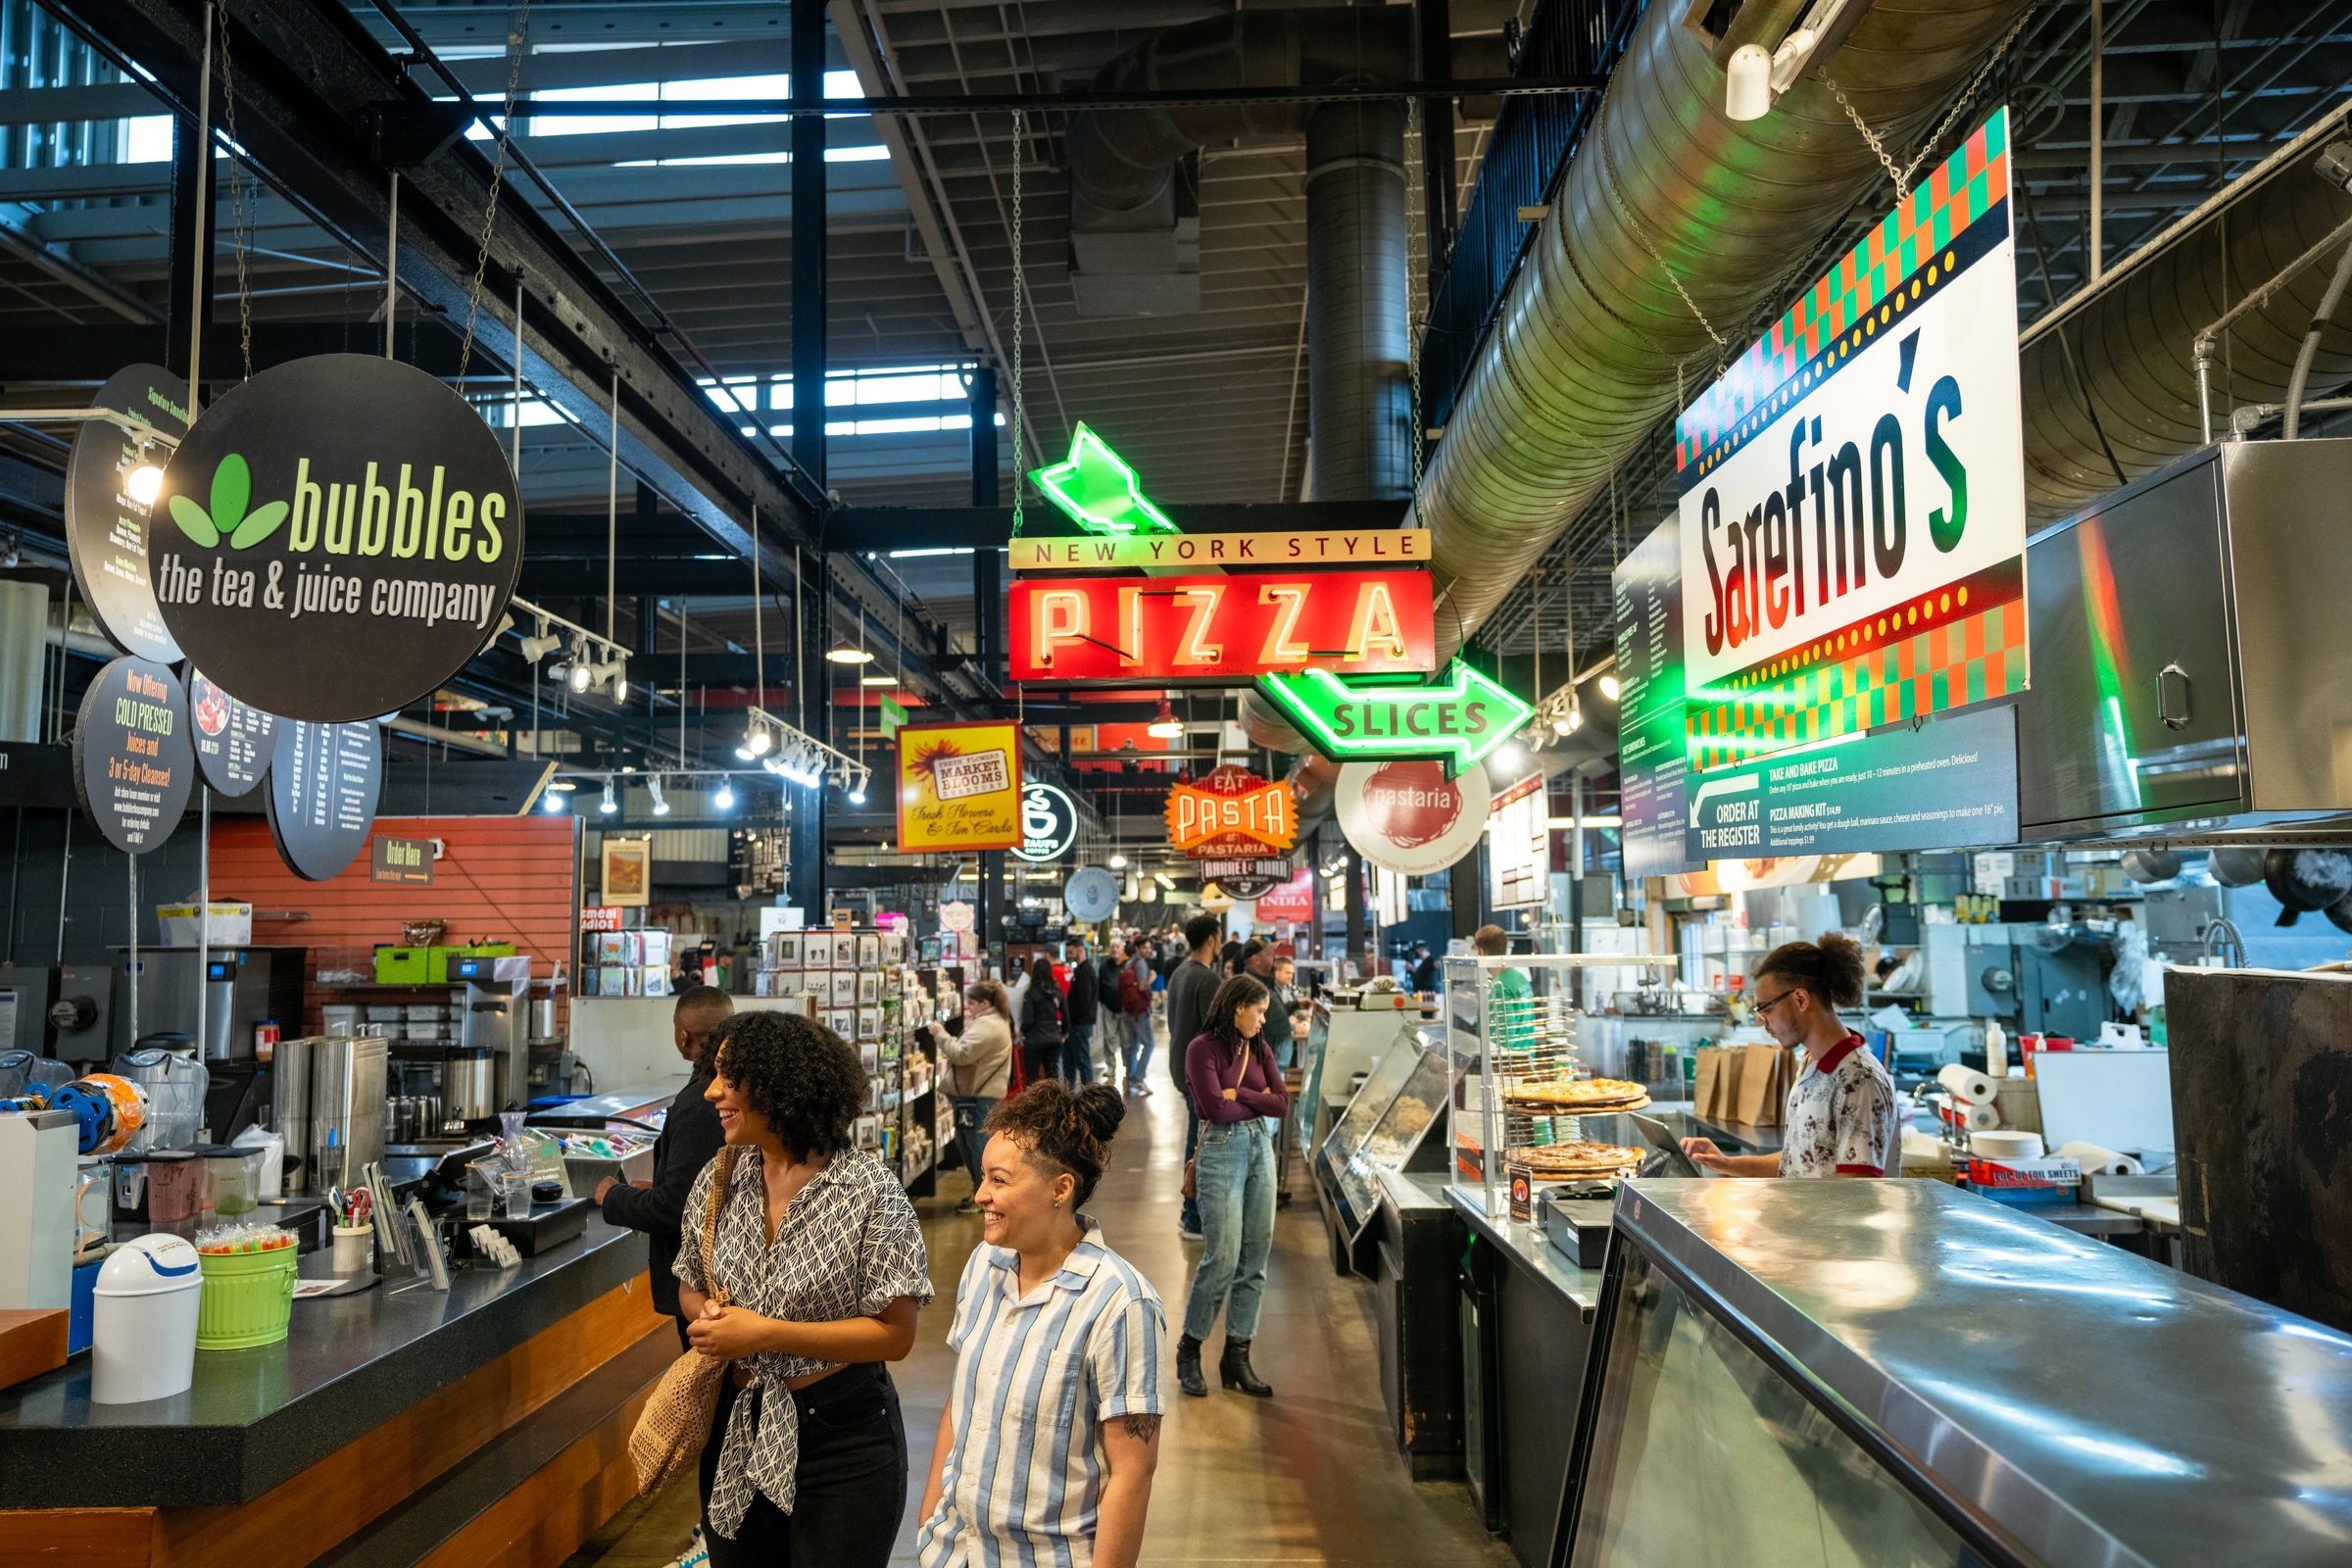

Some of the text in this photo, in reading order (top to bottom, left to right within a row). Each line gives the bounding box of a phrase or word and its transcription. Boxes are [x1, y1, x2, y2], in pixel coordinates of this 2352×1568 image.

[289, 458, 506, 564] bubbles
[1035, 536, 1413, 564] NEW YORK STYLE
[159, 554, 496, 630] the tea & juice company
[1030, 581, 1409, 669] PIZZA
[126, 668, 168, 704] Now Offering
[116, 697, 173, 736] COLD PRESSED
[1334, 702, 1488, 737] SLICES
[126, 730, 159, 757] Juices and
[109, 757, 171, 787] 3 or 5-day Cleanses!
[940, 760, 1000, 779] MARKET
[1769, 757, 1838, 782] TAKE AND BAKE PIZZA
[1877, 767, 1882, 777] 12
[1883, 766, 1900, 776] minutes
[1911, 759, 1936, 774] preheated
[1936, 759, 1950, 768] oven.
[1951, 751, 1978, 765] Delicious!
[942, 771, 1003, 791] BLOOMS
[943, 782, 1003, 798] EVERYDAY
[1214, 769, 1249, 793] EAT
[1374, 786, 1450, 809] pastaria
[1176, 789, 1285, 843] PASTA
[1717, 799, 1759, 824] ORDER AT
[1769, 808, 1788, 822] PIZZA
[1788, 804, 1814, 819] MAKING
[1815, 802, 1827, 816] KIT
[1893, 812, 1910, 823] cheese
[1910, 810, 1920, 821] and
[1921, 808, 1948, 821] seasonings
[1949, 809, 1955, 818] to
[1956, 806, 1971, 816] make
[1971, 807, 1983, 816] one
[1993, 803, 2005, 816] pie.
[1700, 829, 1717, 849] THE
[1718, 824, 1760, 848] REGISTER
[387, 840, 420, 866] Order Here
[1198, 844, 1268, 856] PASTARIA
[1204, 860, 1248, 878] BARREL
[1256, 860, 1288, 878] BOAR
[1259, 896, 1308, 906] INDIA
[2028, 1170, 2046, 1180] FOIL
[2047, 1169, 2079, 1179] SHEETS
